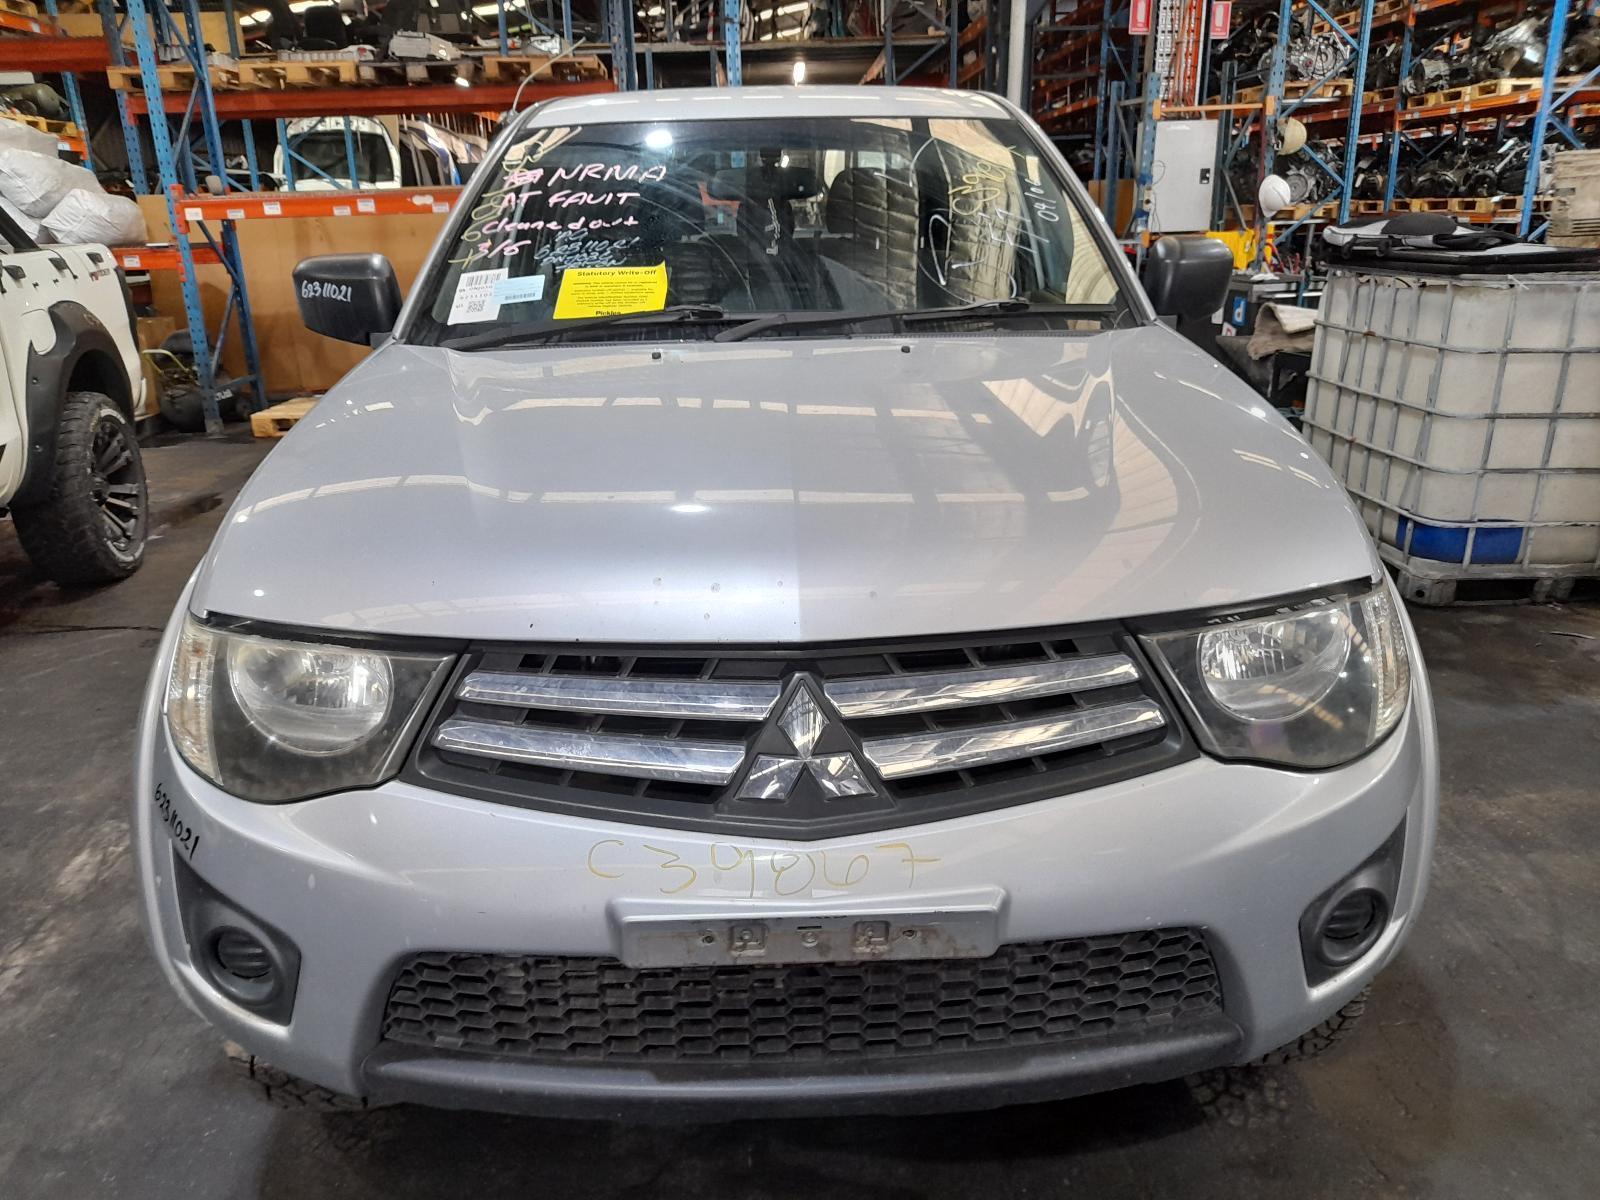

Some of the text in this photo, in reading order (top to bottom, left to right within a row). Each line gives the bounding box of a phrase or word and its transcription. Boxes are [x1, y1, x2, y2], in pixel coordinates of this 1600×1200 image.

[547, 163, 668, 188] NRMA
[499, 190, 543, 212] AT
[301, 280, 352, 302] 62311021
